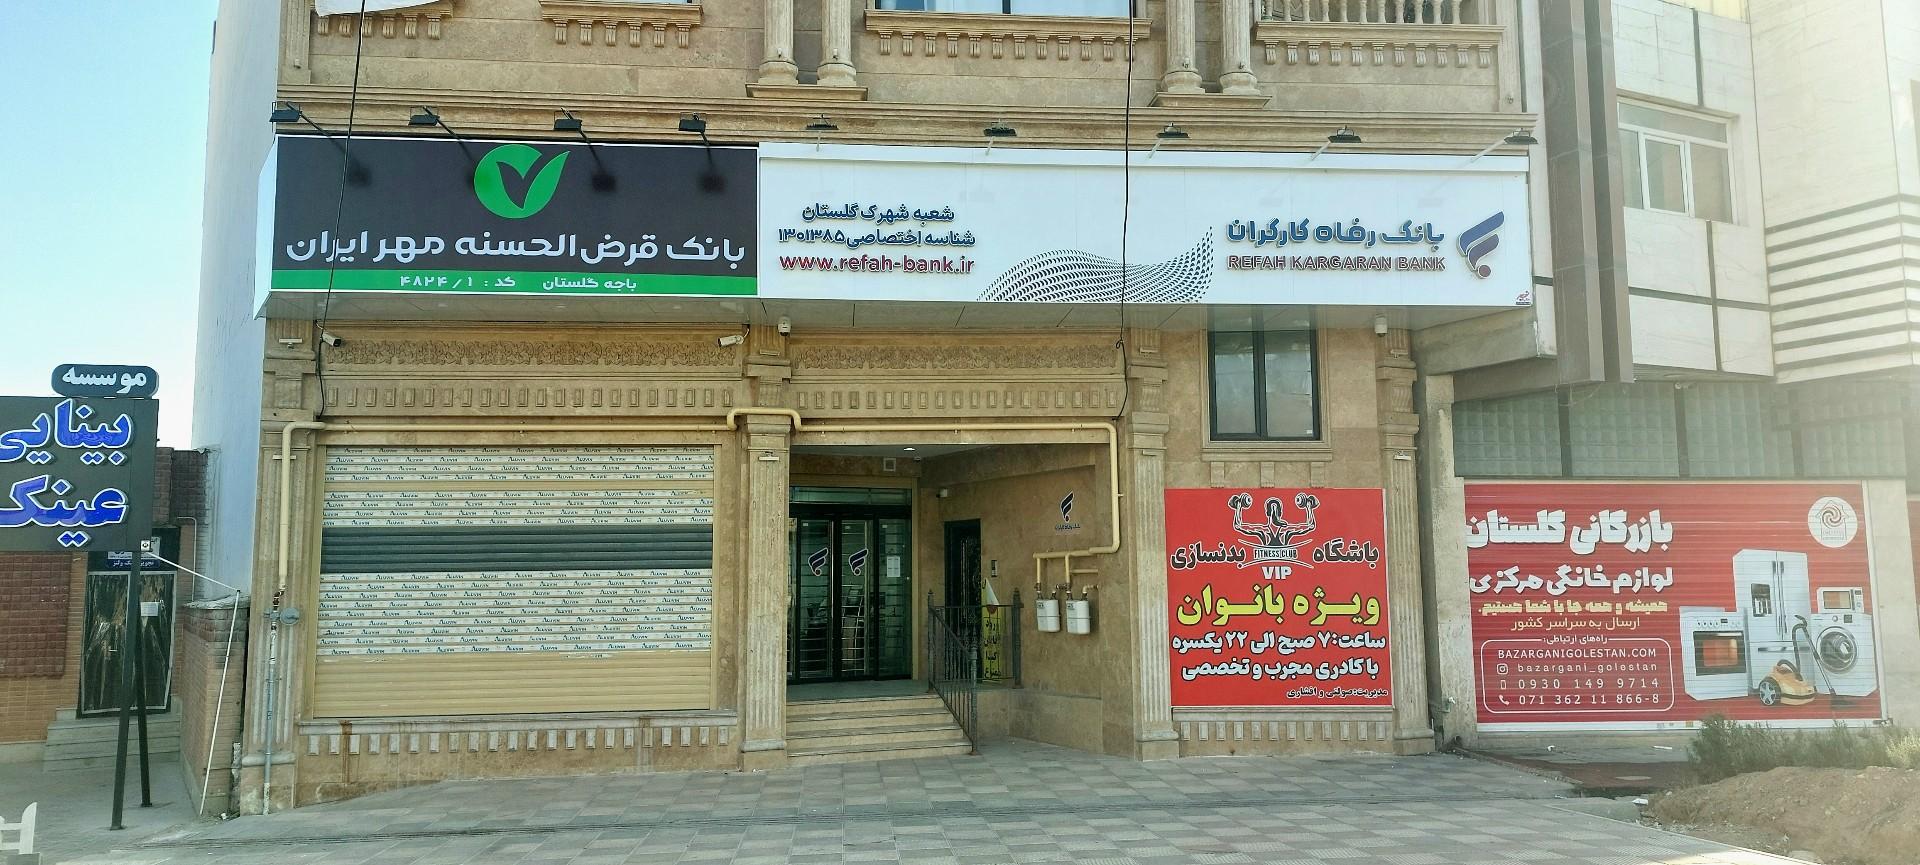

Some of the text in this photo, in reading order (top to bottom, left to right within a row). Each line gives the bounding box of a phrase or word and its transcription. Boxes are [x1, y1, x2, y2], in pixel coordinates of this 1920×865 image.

[802, 203, 955, 226] شعبه شهرک گلستان
[925, 230, 976, 247] شناسه
[1226, 217, 1445, 252] بانک رفاه کارگران
[285, 230, 368, 264] ایران
[371, 233, 444, 264] مهر
[666, 233, 746, 270] بانک
[779, 254, 975, 275] www.refah-bank.ir
[1227, 255, 1446, 272] REFAH KARGARAN BANK
[542, 277, 599, 291] گلستان
[604, 278, 637, 290] باجه
[62, 366, 147, 393] موسسه
[0, 398, 132, 465] بینایی
[0, 474, 129, 547] عینک
[1465, 509, 1673, 555] بازرگانی گلستان
[1170, 537, 1379, 570] باشگاه بدنسازی
[1254, 549, 1298, 559] FITNESS CLUB
[1262, 566, 1292, 580] VIP
[1470, 564, 1673, 596] لوازم خانگی مرکزی
[1176, 583, 1381, 626] ویژه بانوان
[1525, 599, 1551, 613] شما
[1553, 600, 1565, 616] با
[1585, 600, 1612, 613] همه
[1615, 603, 1623, 614] و
[1625, 600, 1668, 614] همیشه
[1511, 616, 1641, 632] ارسال به سراسر کشور
[1172, 631, 1223, 654] یکسره
[1225, 630, 1248, 649] ۲۲
[1250, 631, 1275, 654] الی
[1278, 633, 1317, 655] صبح
[1498, 648, 1657, 660] BAZARGANIGOLESTAN.COM
[1181, 656, 1380, 681] با کادری مجرب و تخصصی
[1517, 662, 1658, 674] bazargani_golestan
[1286, 686, 1317, 699] افشاری
[1518, 678, 1660, 690] 0930 149 9714
[1318, 689, 1324, 698] و
[1519, 695, 1660, 706] 071 362 11 866-8
